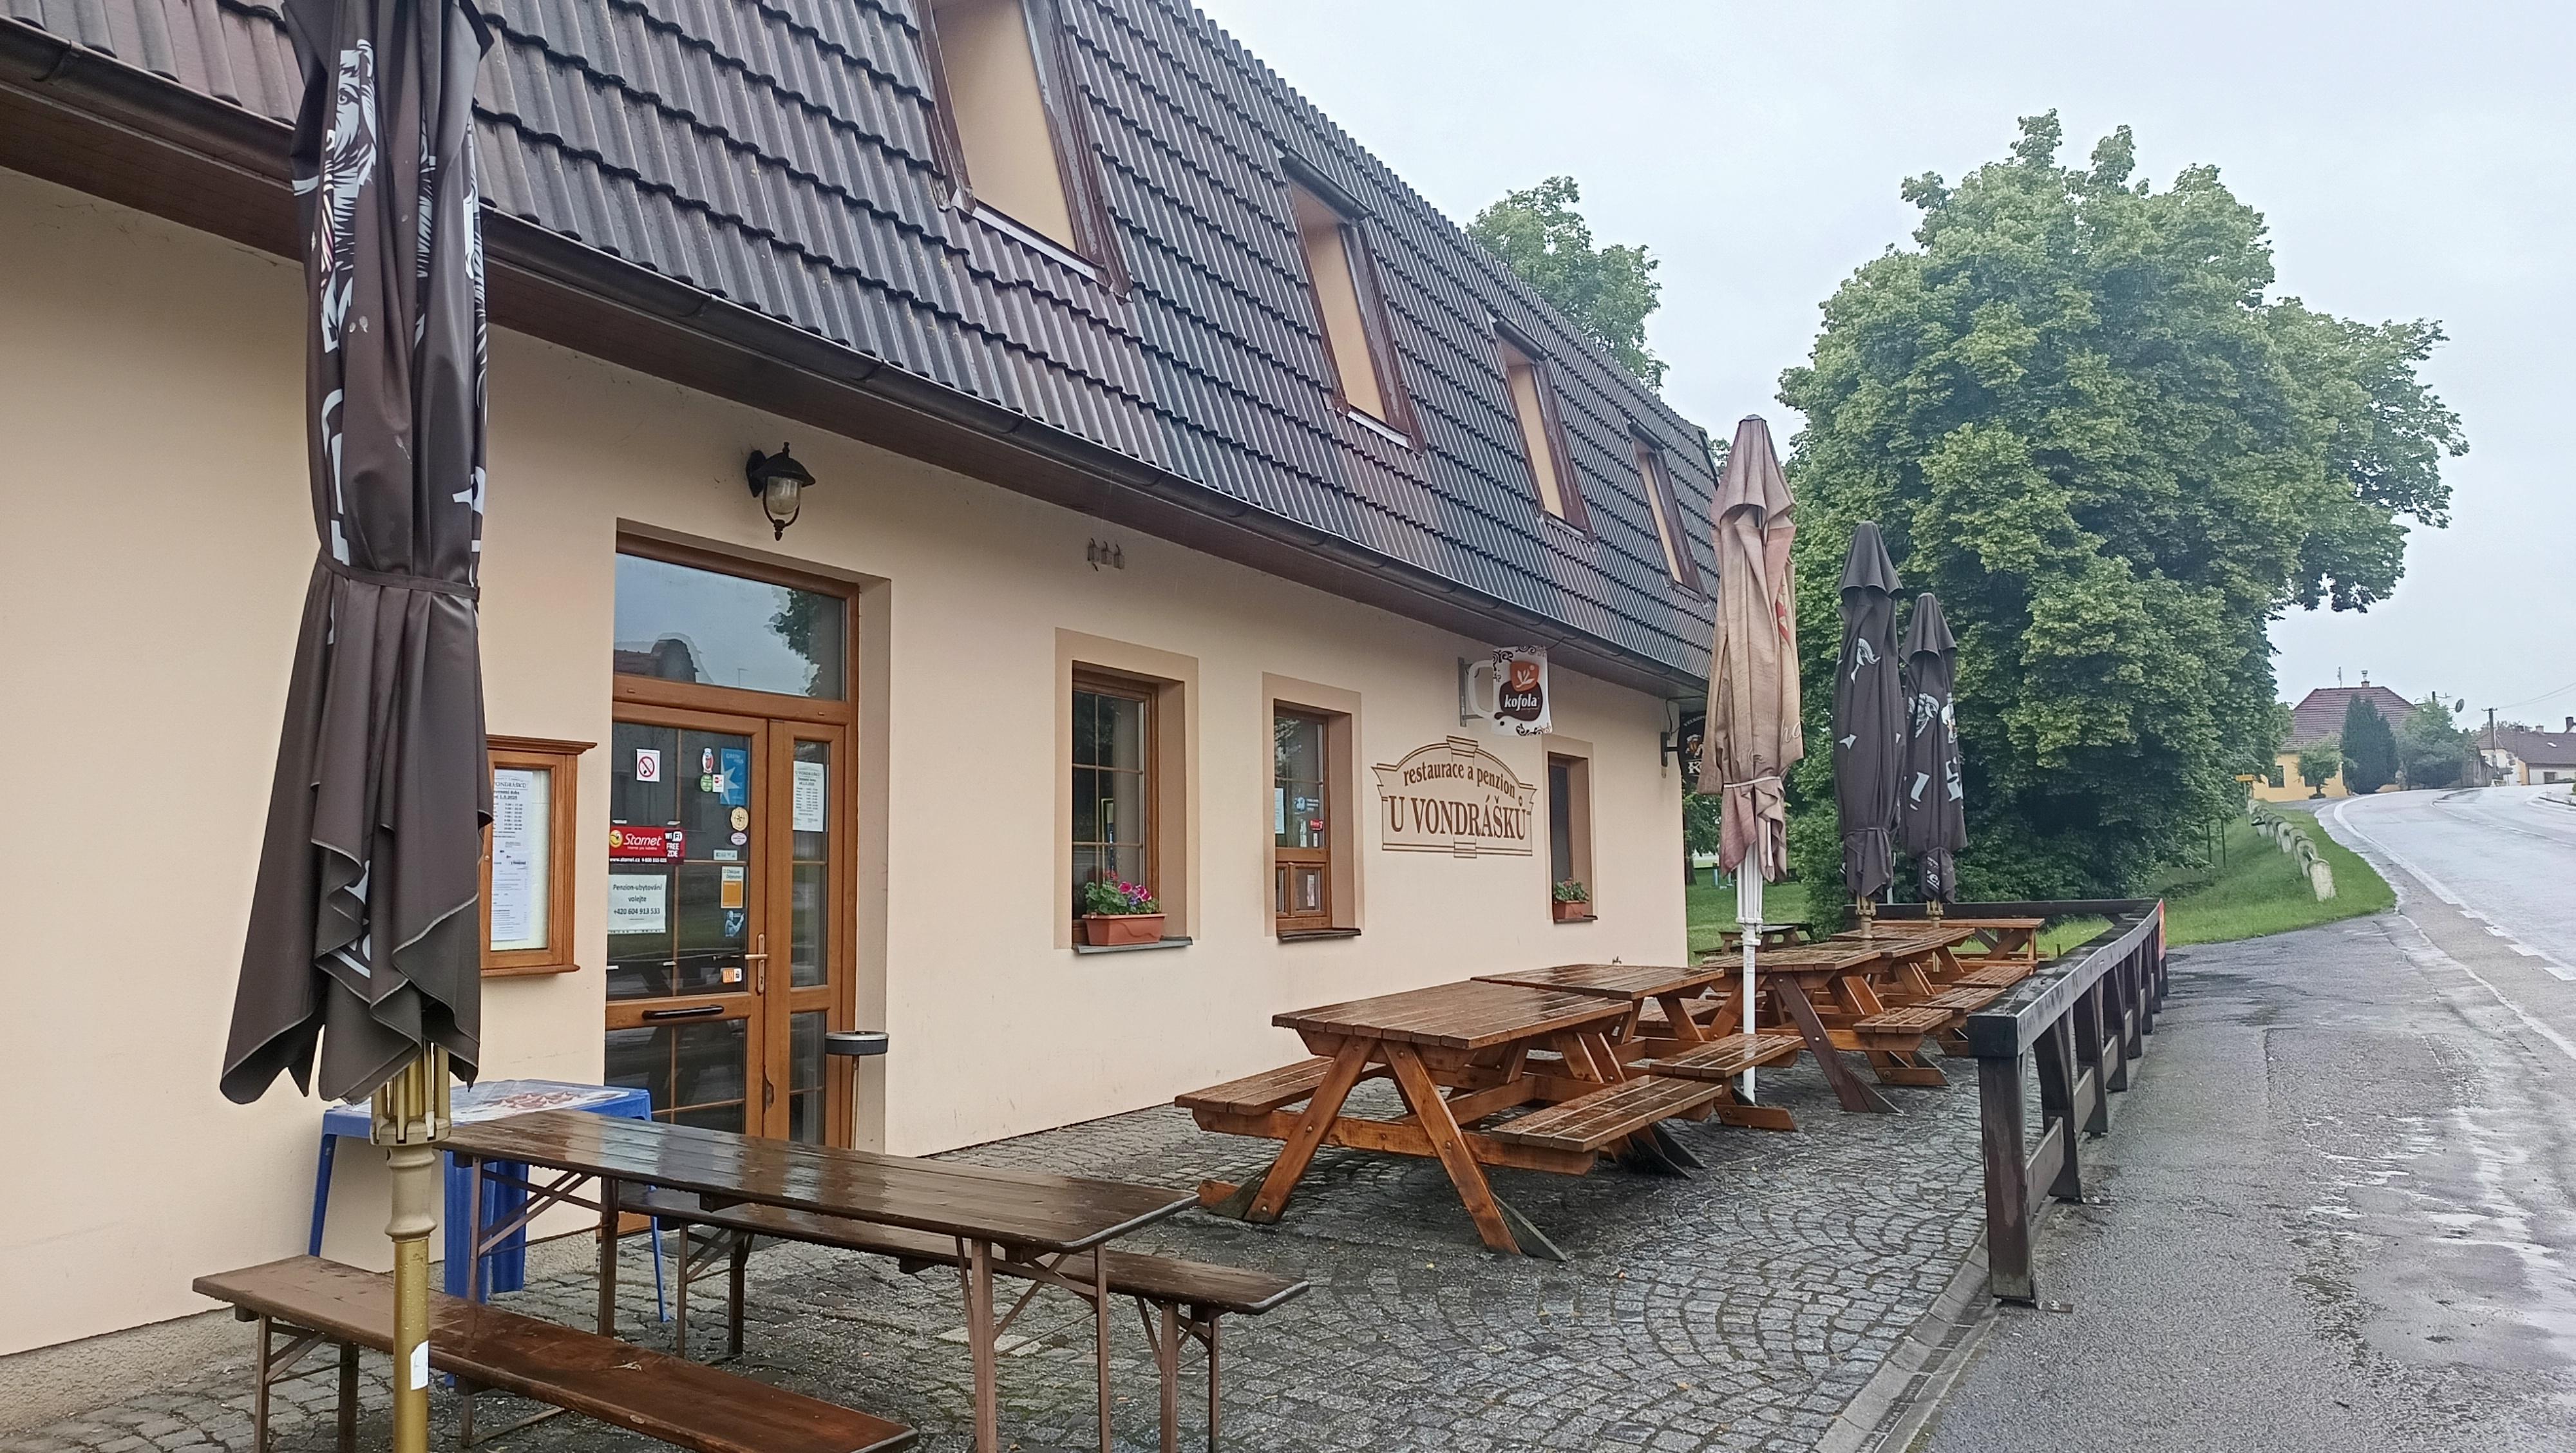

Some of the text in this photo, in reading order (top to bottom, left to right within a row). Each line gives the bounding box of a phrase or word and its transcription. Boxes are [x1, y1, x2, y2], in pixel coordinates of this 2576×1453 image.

[1504, 694, 1537, 711] kofola
[1403, 762, 1515, 799] restaurace a penzion
[1388, 794, 1526, 840] U VONDRÁŠKŮ
